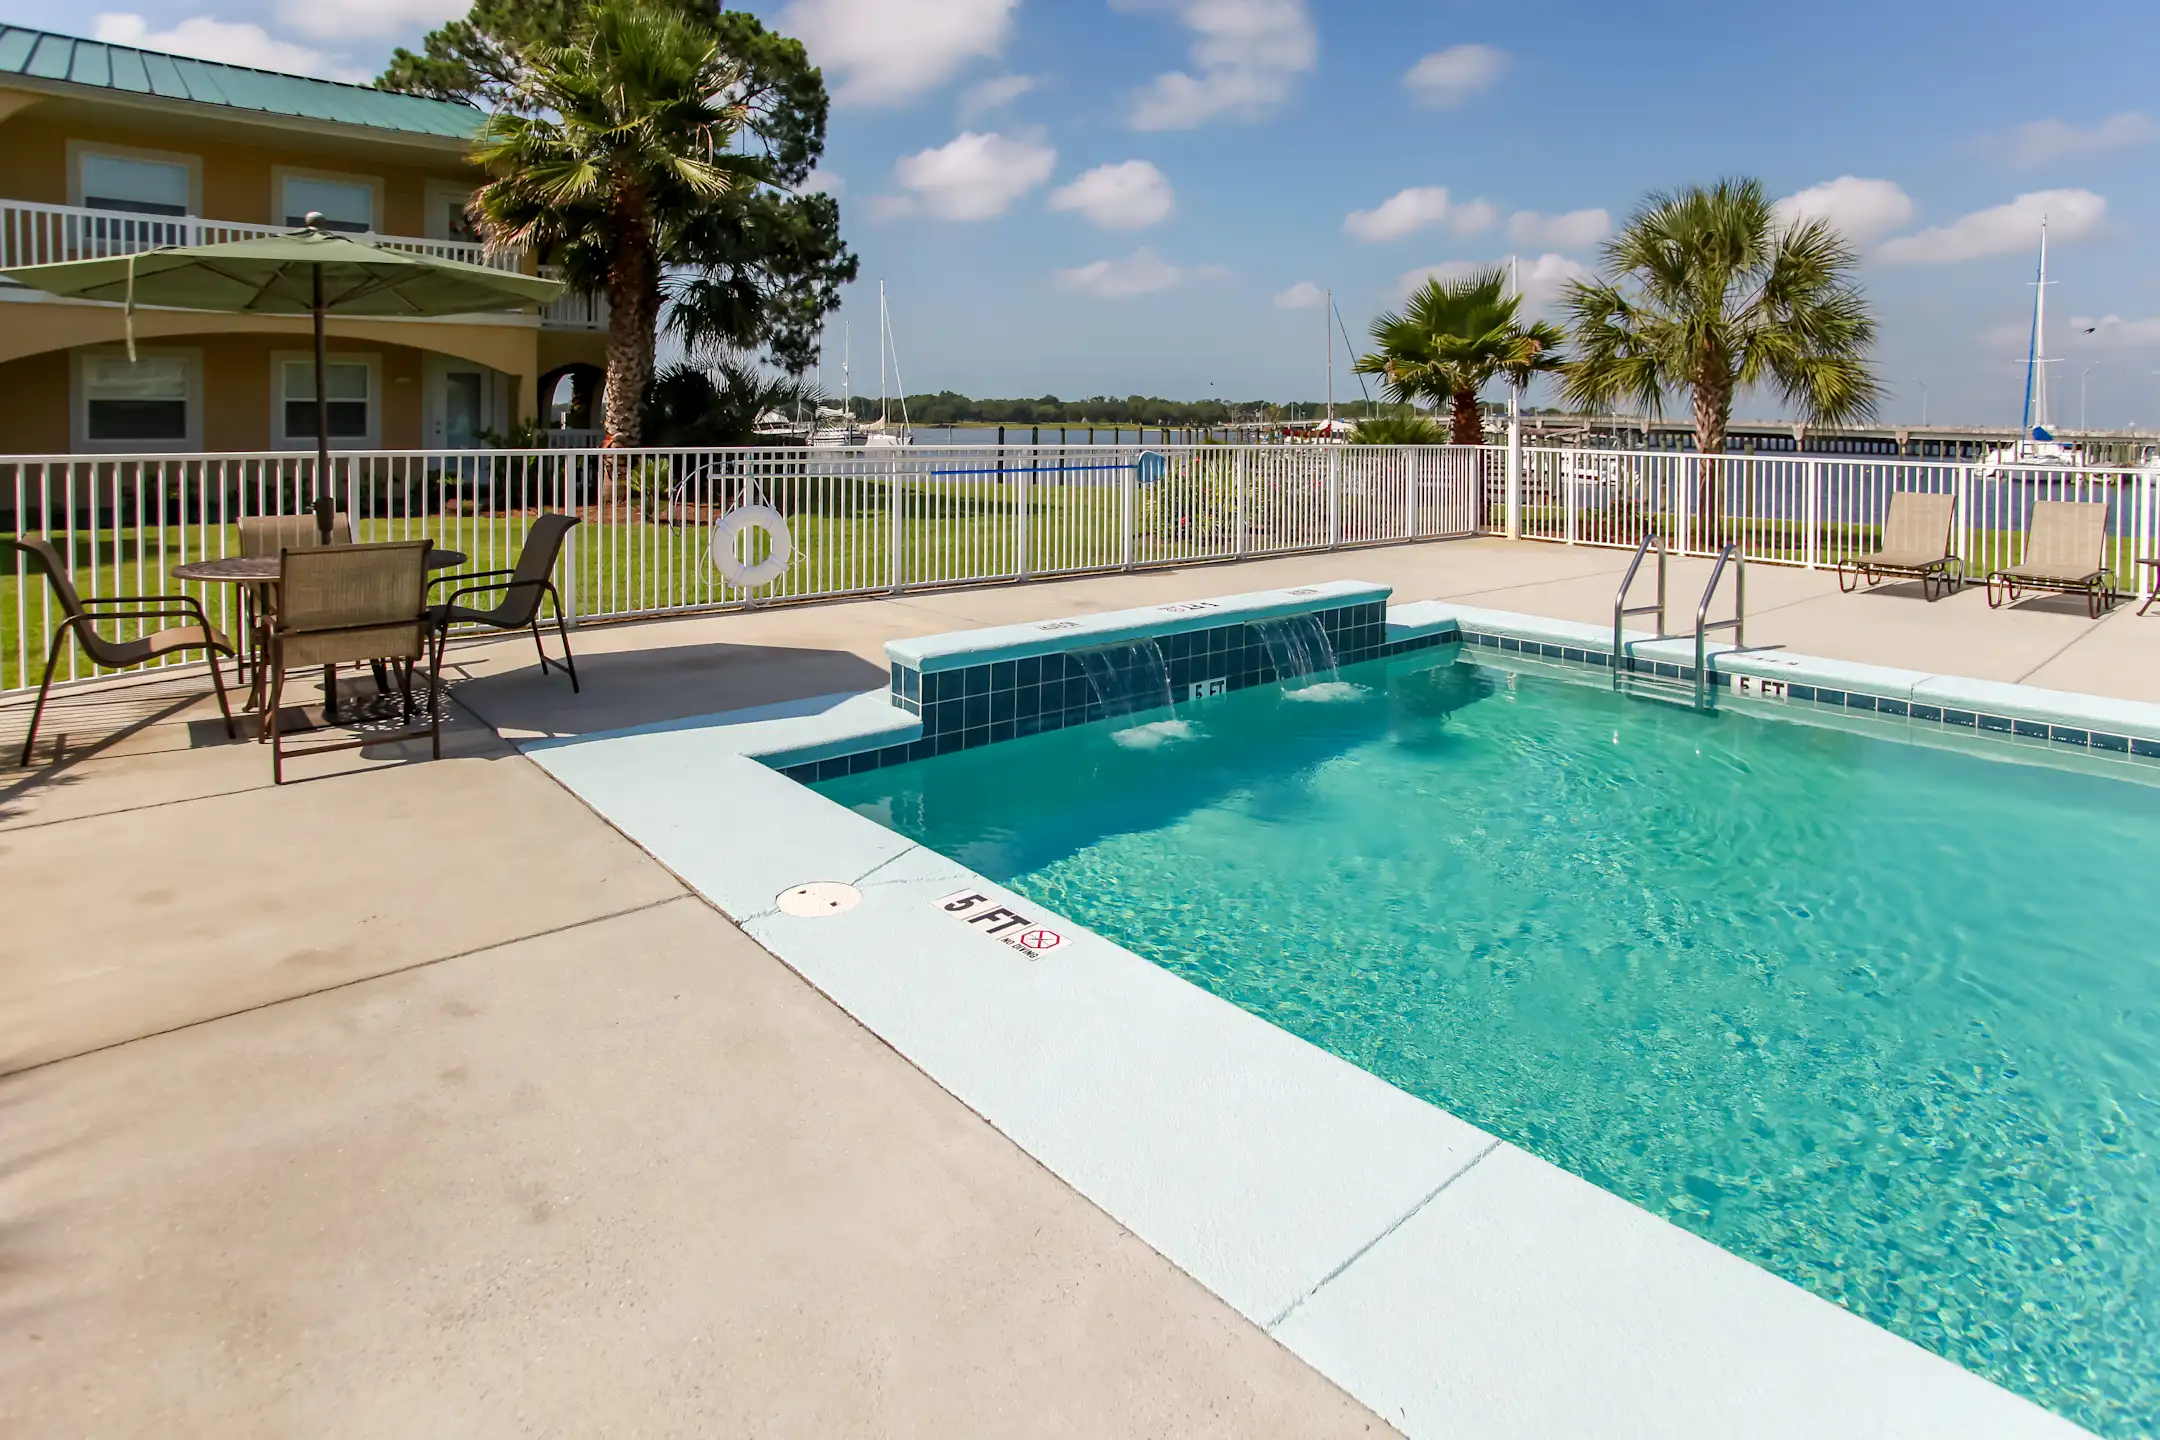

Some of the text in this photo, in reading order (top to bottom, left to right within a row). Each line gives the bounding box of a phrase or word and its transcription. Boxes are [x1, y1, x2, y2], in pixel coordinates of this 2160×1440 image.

[1209, 680, 1225, 696] FT
[1762, 680, 1784, 694] FT
[944, 894, 1032, 935] 5 FT
[1000, 937, 1040, 959] NO DIVING
